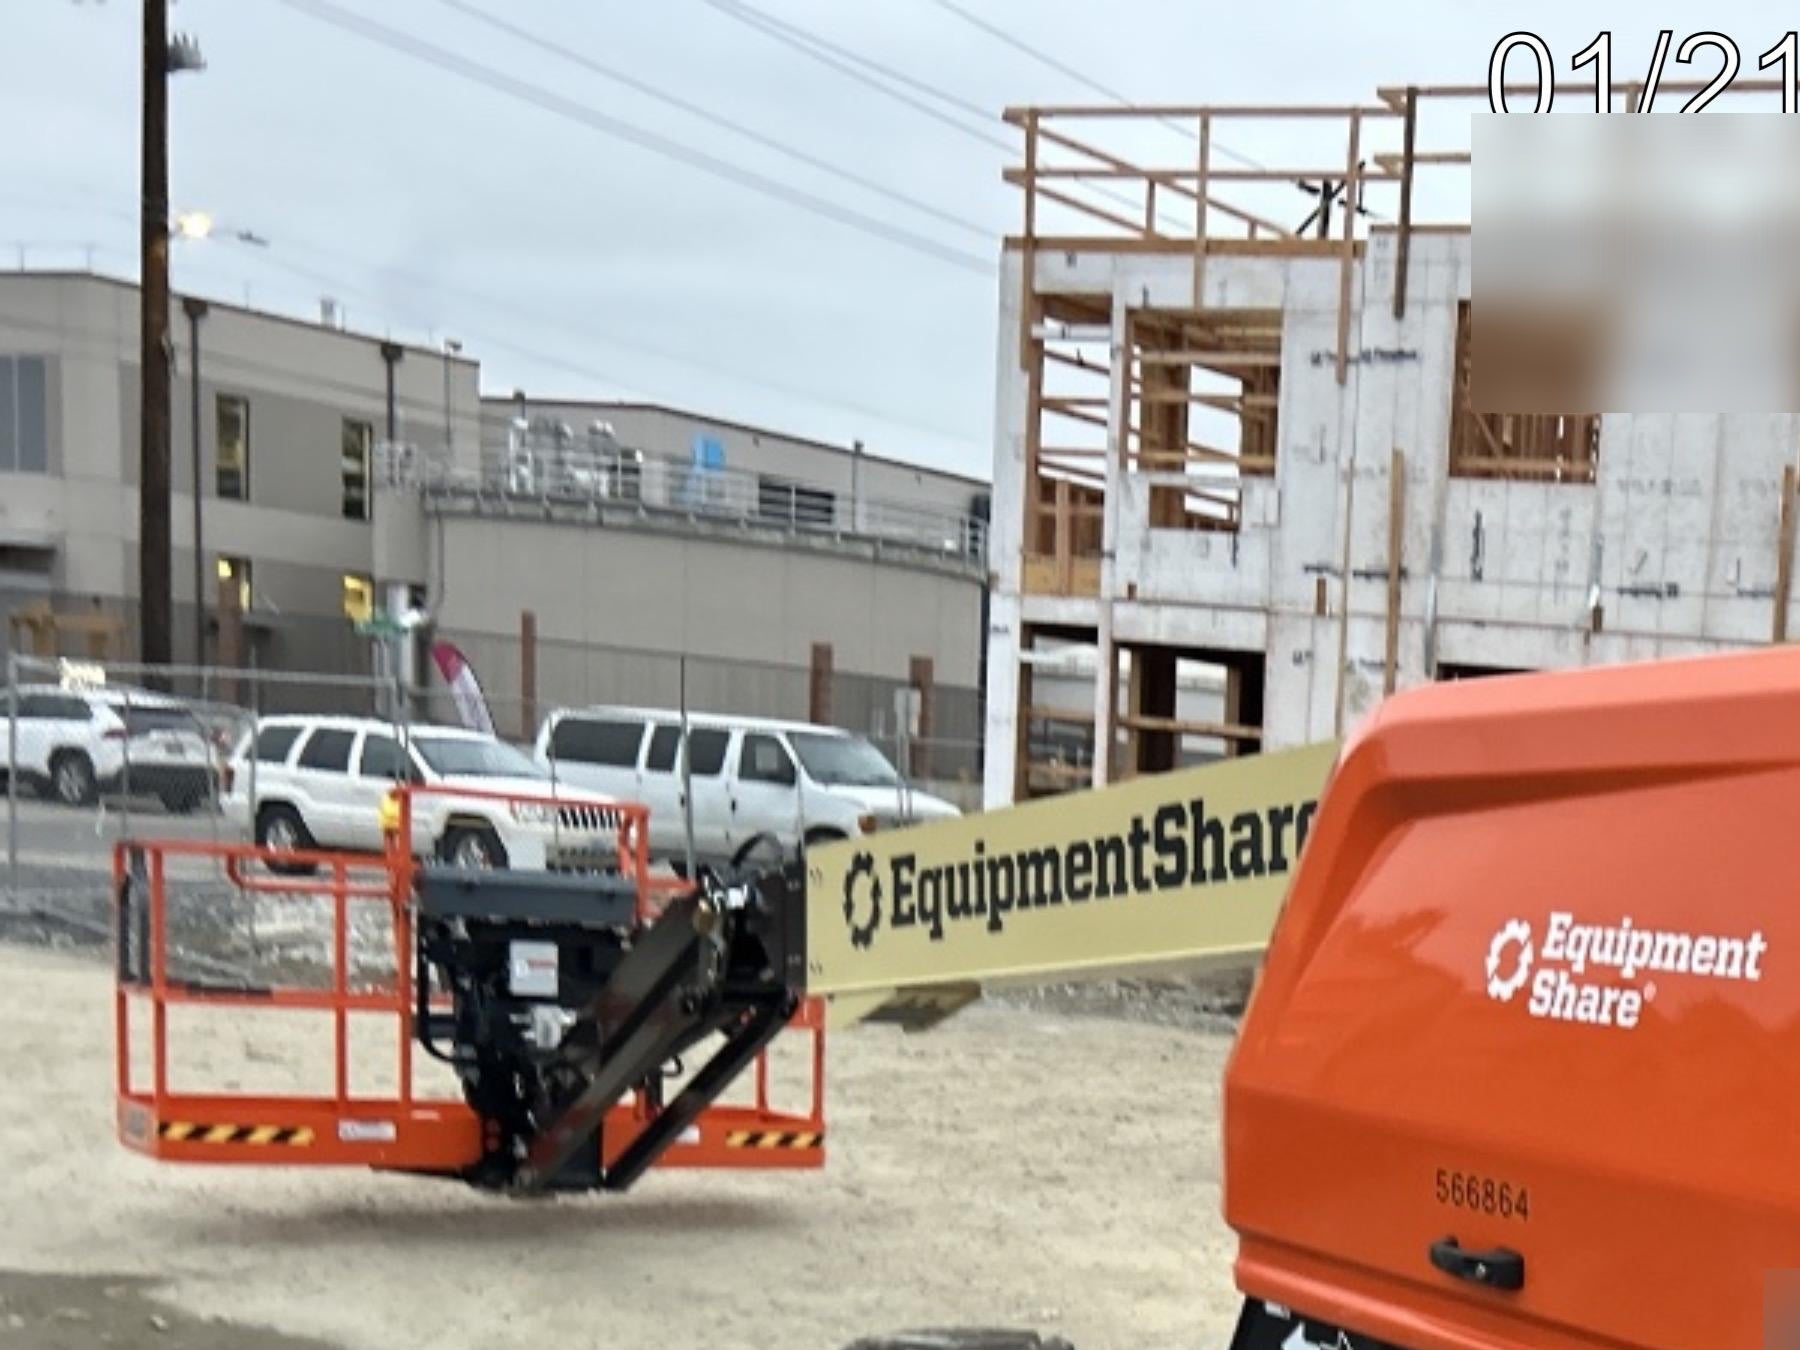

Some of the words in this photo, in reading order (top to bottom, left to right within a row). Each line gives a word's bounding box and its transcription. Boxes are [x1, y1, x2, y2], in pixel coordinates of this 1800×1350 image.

[1542, 911, 1768, 981] Equipment
[1527, 968, 1644, 1029] Share
[1436, 1168, 1530, 1222] 566864
